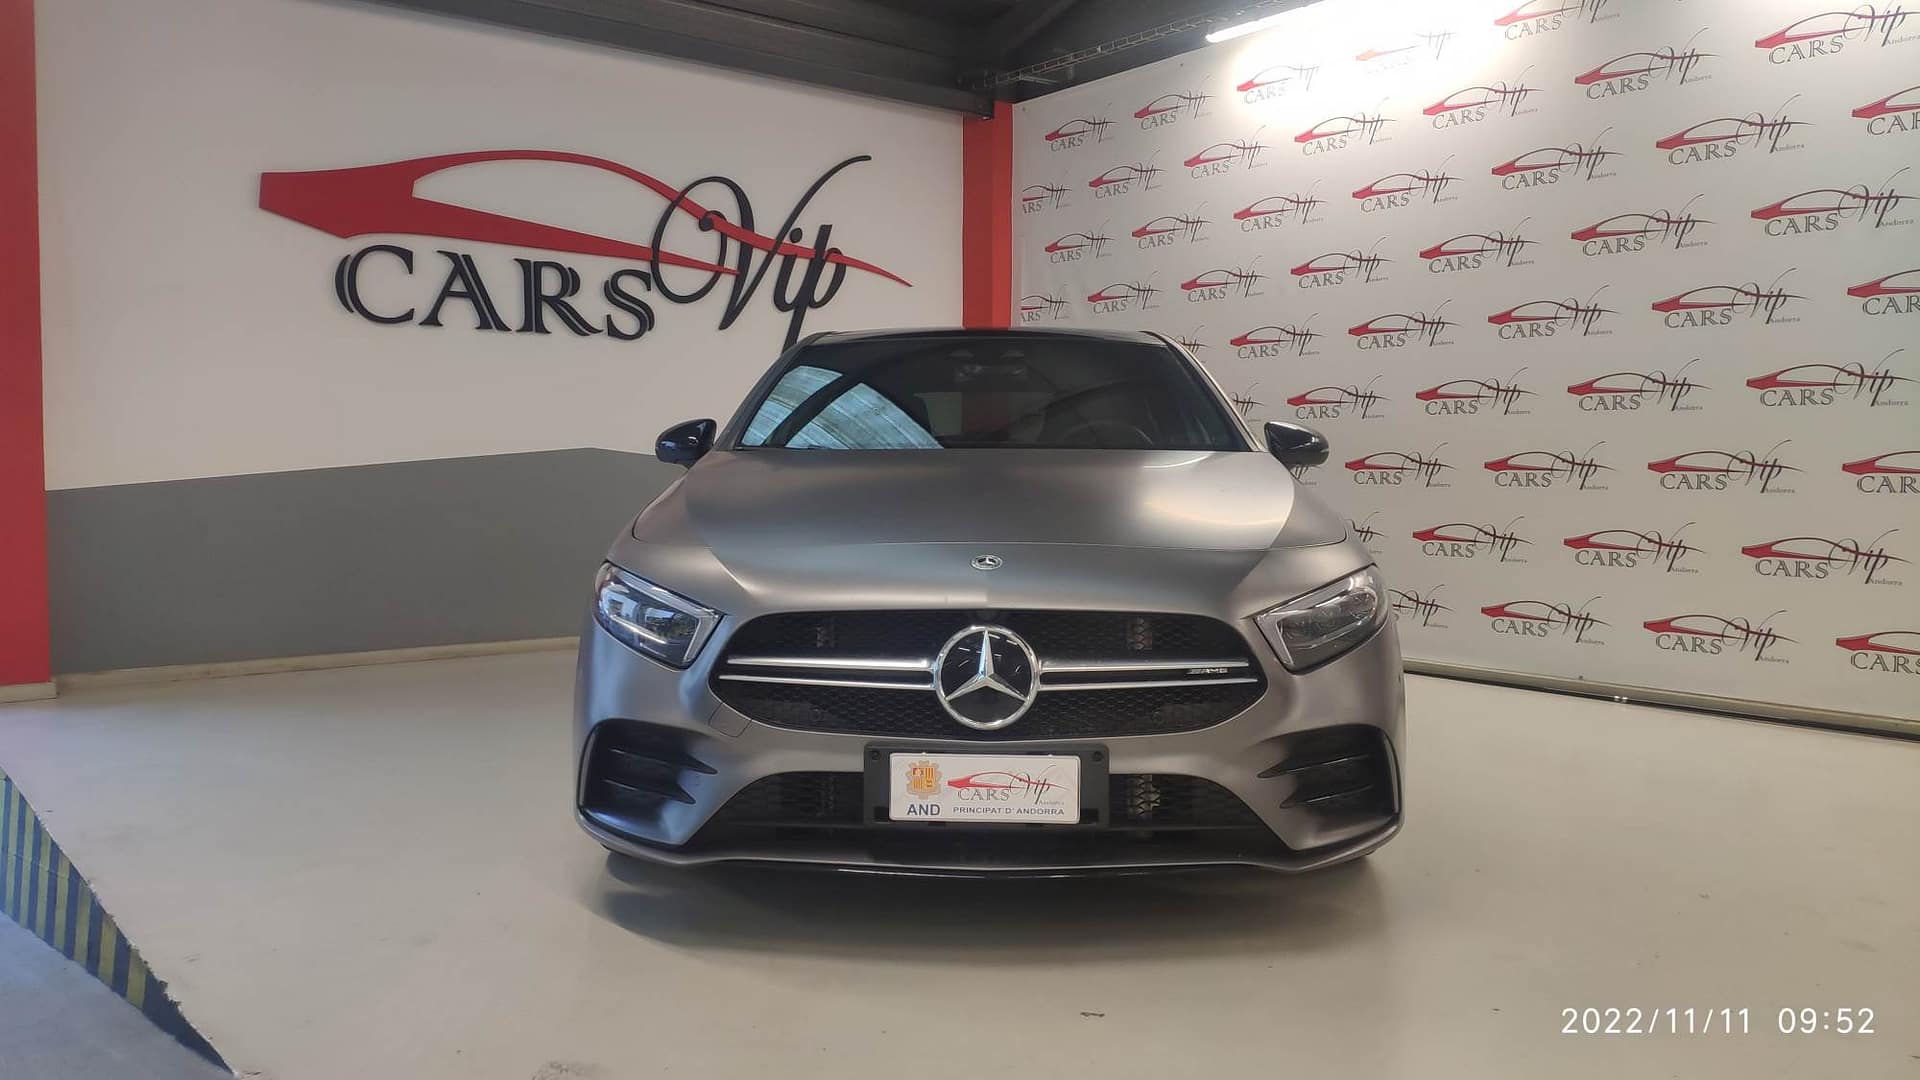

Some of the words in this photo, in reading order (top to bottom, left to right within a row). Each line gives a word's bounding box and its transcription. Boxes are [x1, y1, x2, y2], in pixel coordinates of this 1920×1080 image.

[1504, 14, 1562, 40] CARS
[1769, 36, 1843, 65] CARS
[1586, 74, 1648, 100] CARS
[1433, 106, 1485, 130] CARS
[1303, 135, 1347, 156] CARS
[1668, 141, 1736, 165] CARS
[1191, 161, 1229, 179] CARS
[1502, 168, 1559, 190] CARS
[1361, 193, 1409, 212] CARS
[1240, 215, 1282, 232] CARS
[1765, 214, 1839, 236] CARS
[1583, 235, 1645, 256] CARS
[1429, 254, 1481, 273] CARS
[1299, 272, 1344, 289] CARS
[334, 244, 655, 341] CARS
[1188, 287, 1226, 302] CARS
[1665, 309, 1732, 328] CARS
[1499, 322, 1556, 339] CARS
[1357, 333, 1405, 350] CARS
[1238, 344, 1278, 359] CARS
[1579, 394, 1641, 411] CARS
[1760, 389, 1834, 407] CARS
[1295, 405, 1340, 420] CARS
[1426, 399, 1478, 415] CARS
[1353, 471, 1401, 486] CARS
[1495, 472, 1552, 488] CARS
[1660, 473, 1727, 490] CARS
[1422, 542, 1474, 558] CARS
[1575, 549, 1637, 566] CARS
[1755, 560, 1828, 580] CARS
[1492, 619, 1548, 636] CARS
[1656, 634, 1722, 654] CARS
[958, 787, 1010, 801] CARS
[907, 804, 941, 816] AND
[953, 806, 1001, 814] PRINCIPAT
